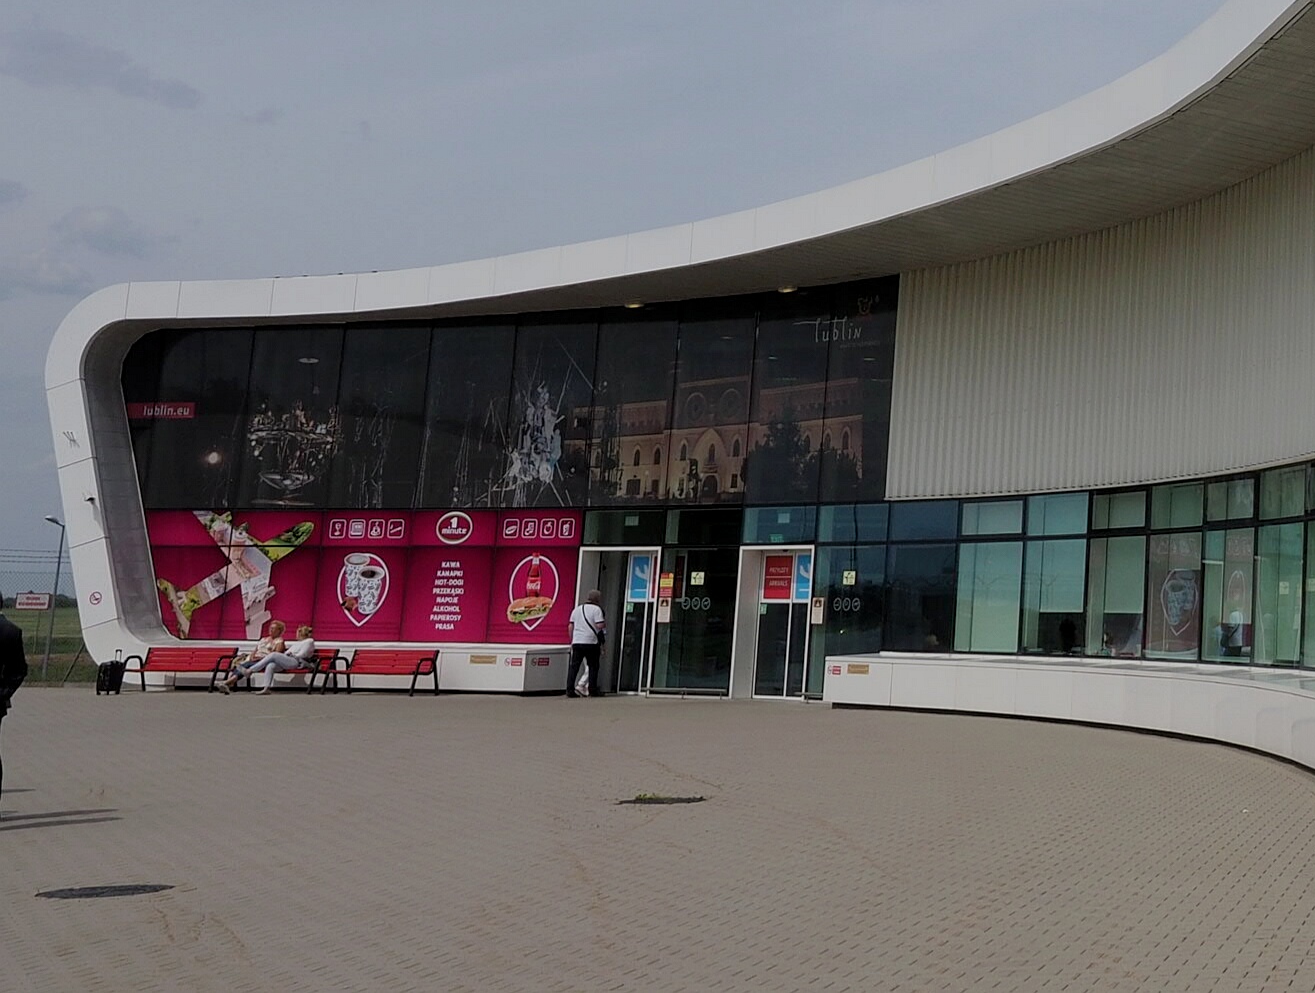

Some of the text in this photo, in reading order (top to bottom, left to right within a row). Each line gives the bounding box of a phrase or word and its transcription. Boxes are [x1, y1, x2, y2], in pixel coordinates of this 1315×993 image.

[143, 405, 190, 416] lublin.eu
[450, 517, 458, 528] 1
[441, 526, 467, 534] minute
